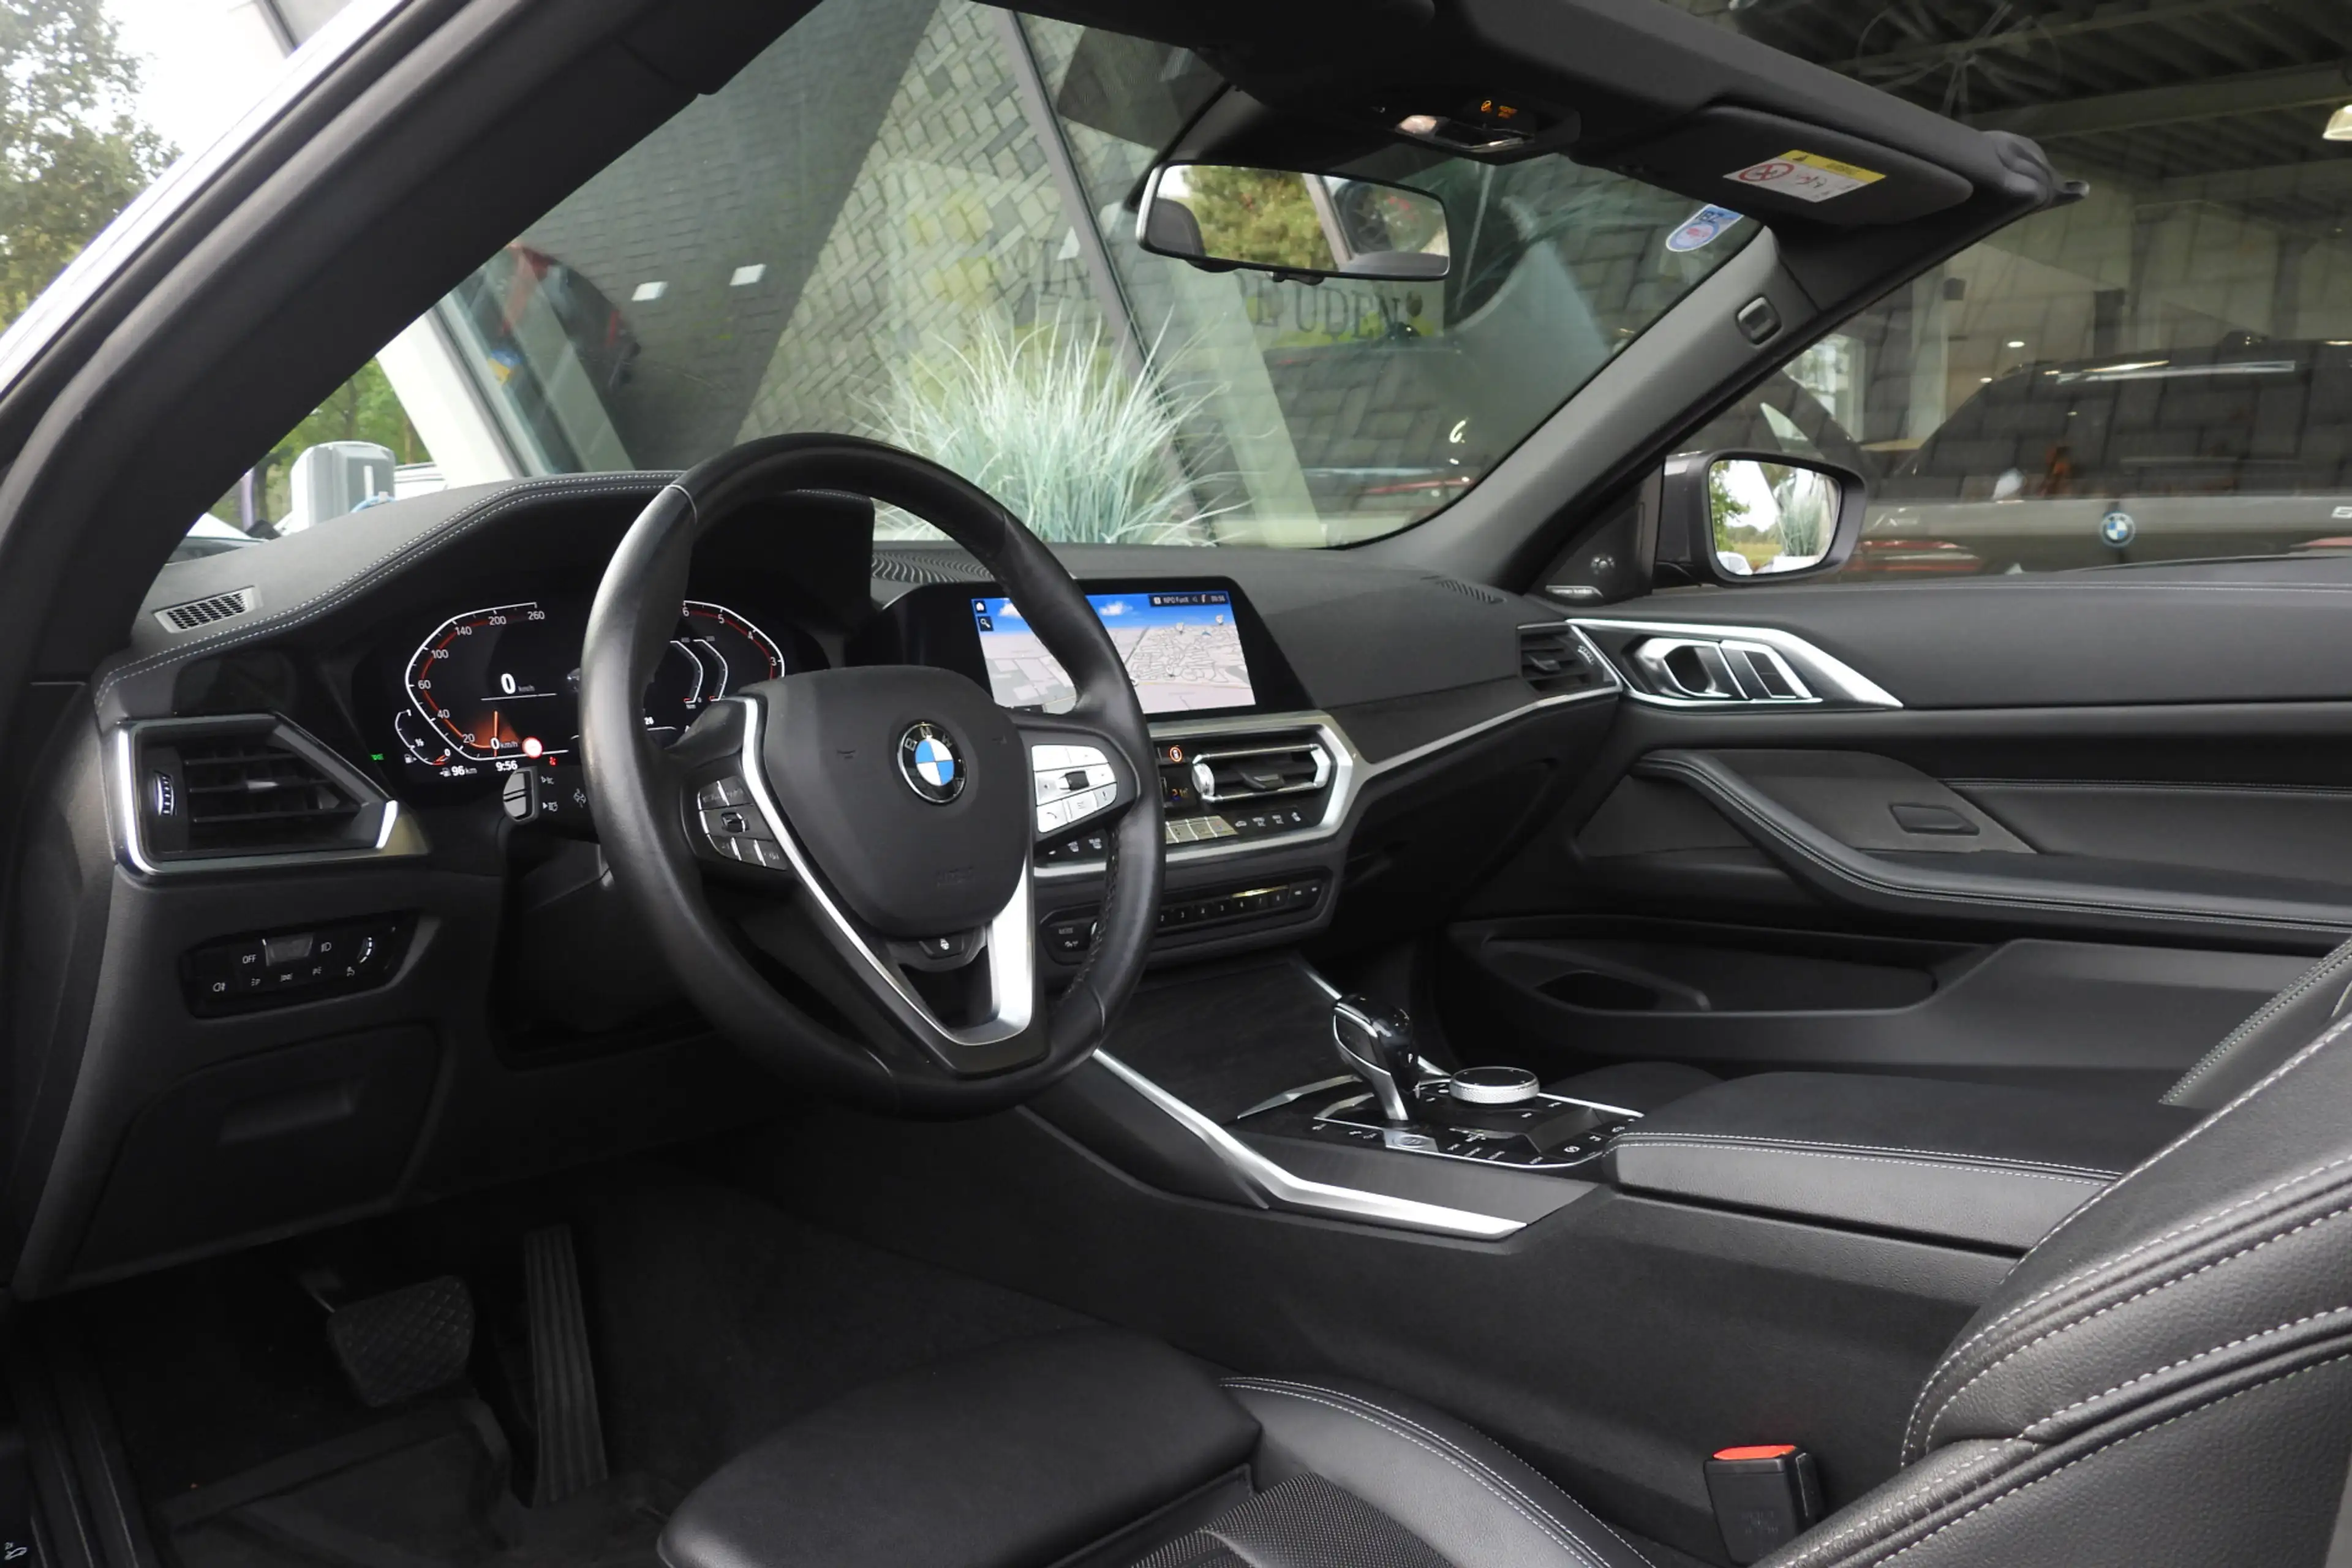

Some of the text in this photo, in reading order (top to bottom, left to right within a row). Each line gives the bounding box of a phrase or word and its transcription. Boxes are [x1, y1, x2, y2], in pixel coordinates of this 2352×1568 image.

[527, 611, 545, 620] 260
[682, 607, 689, 617] 6
[488, 616, 507, 625] 200
[718, 614, 725, 624] 5
[455, 626, 472, 636] 140
[431, 649, 449, 658] 100
[771, 657, 777, 666] 3
[418, 679, 431, 689] 60
[501, 673, 516, 694] 0
[437, 709, 450, 718] 40
[462, 733, 475, 744] 20
[491, 737, 500, 750] 0
[451, 765, 465, 776] 96
[495, 760, 518, 772] 9:56
[242, 954, 257, 964] OFF
